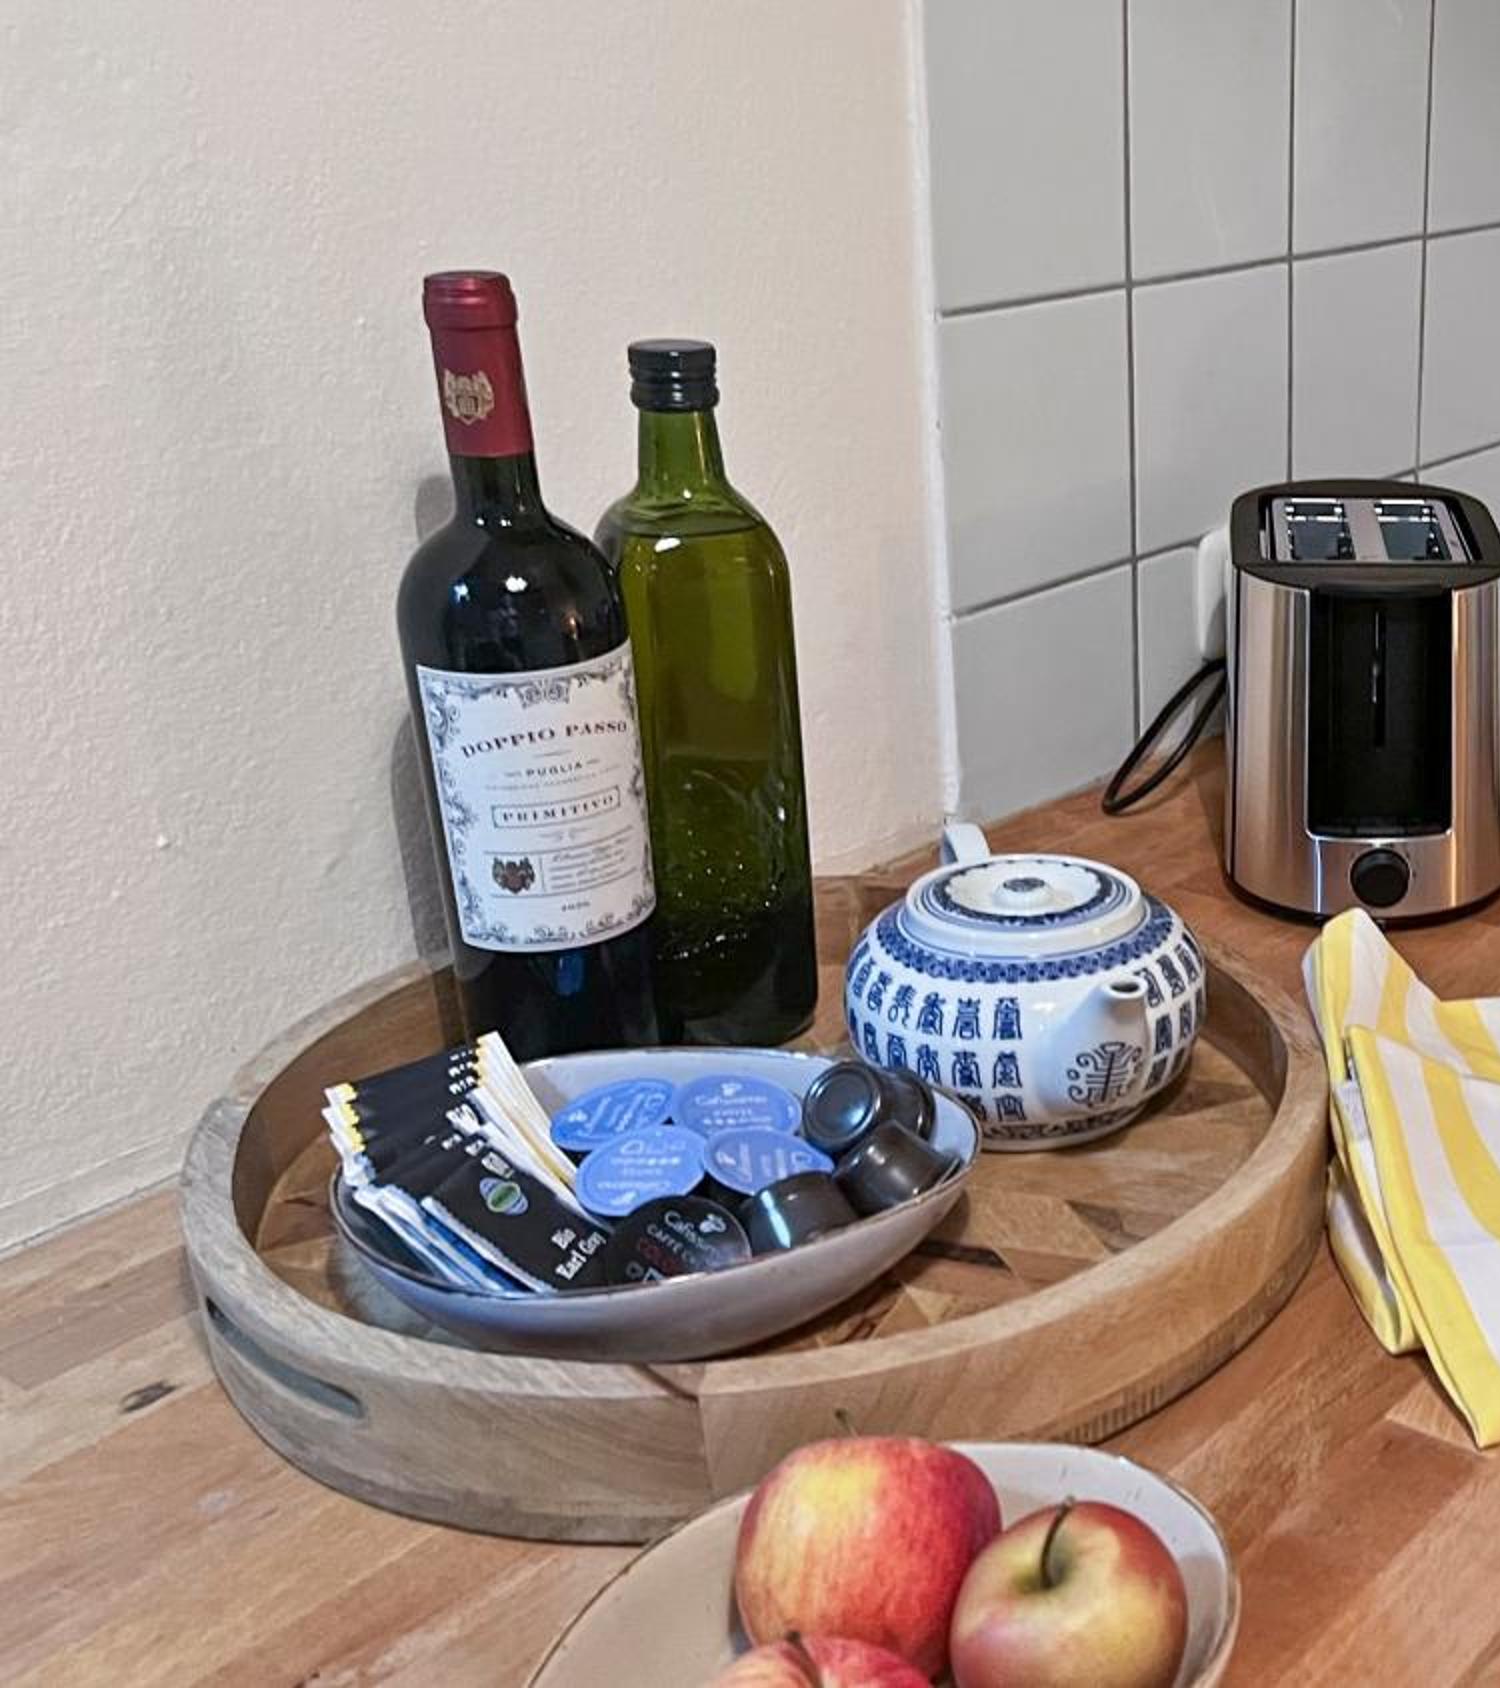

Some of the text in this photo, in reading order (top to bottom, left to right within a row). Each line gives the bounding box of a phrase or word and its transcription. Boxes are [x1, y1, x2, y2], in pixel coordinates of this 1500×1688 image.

[460, 719, 628, 759] DOPPIO PASSO
[525, 761, 583, 777] PUGLIA
[503, 794, 614, 822] PRIMITIVO
[551, 1228, 576, 1250] Bio
[555, 1249, 587, 1280] Earl
